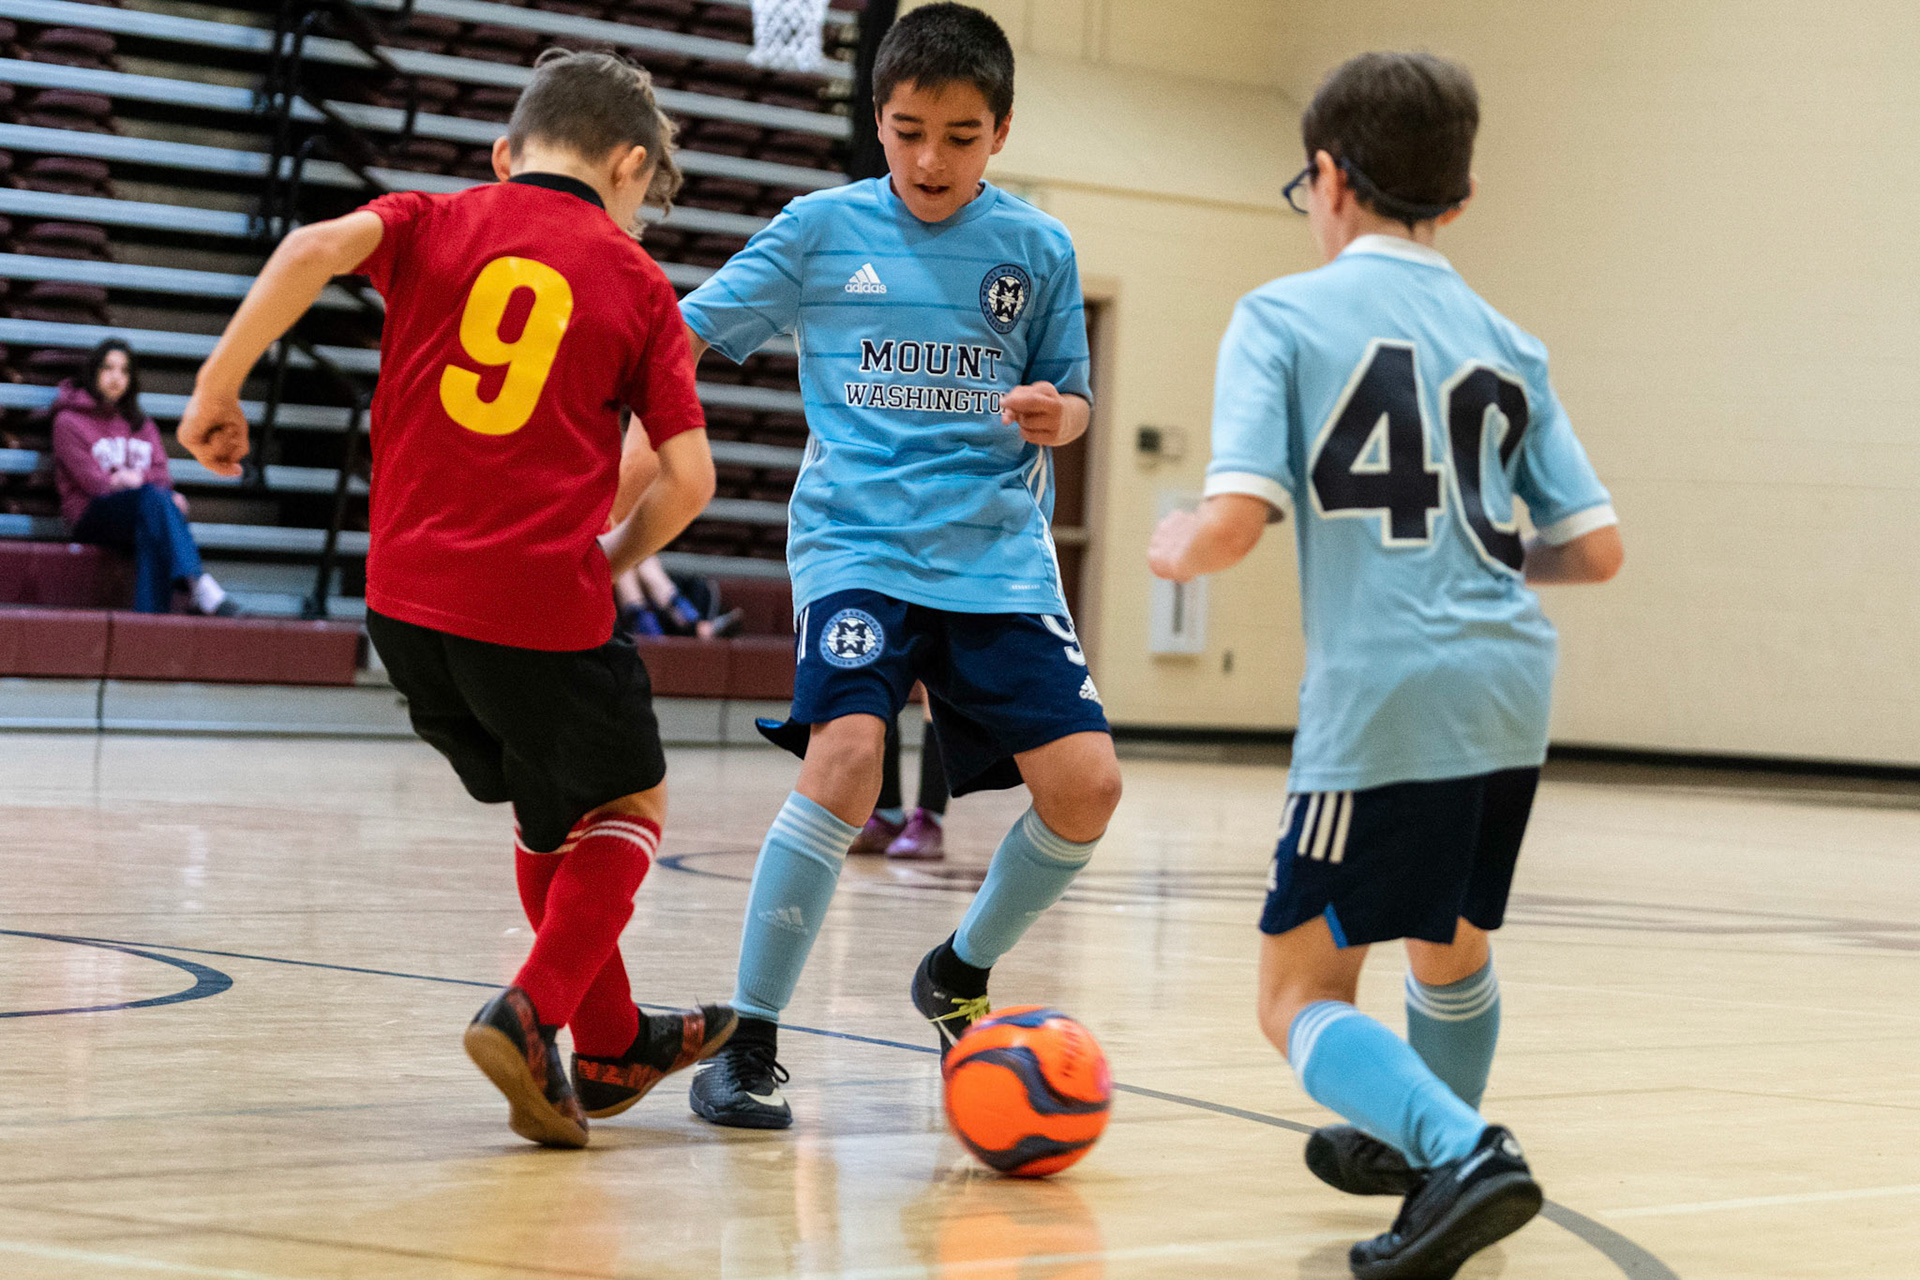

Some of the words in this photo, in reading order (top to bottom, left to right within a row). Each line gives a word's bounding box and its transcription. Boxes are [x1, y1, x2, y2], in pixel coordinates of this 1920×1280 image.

[844, 283, 887, 294] adidas
[439, 256, 574, 436] 9
[859, 339, 1003, 381] MOUNT
[845, 382, 1006, 414] WASHINGTO
[1308, 337, 1529, 575] 40
